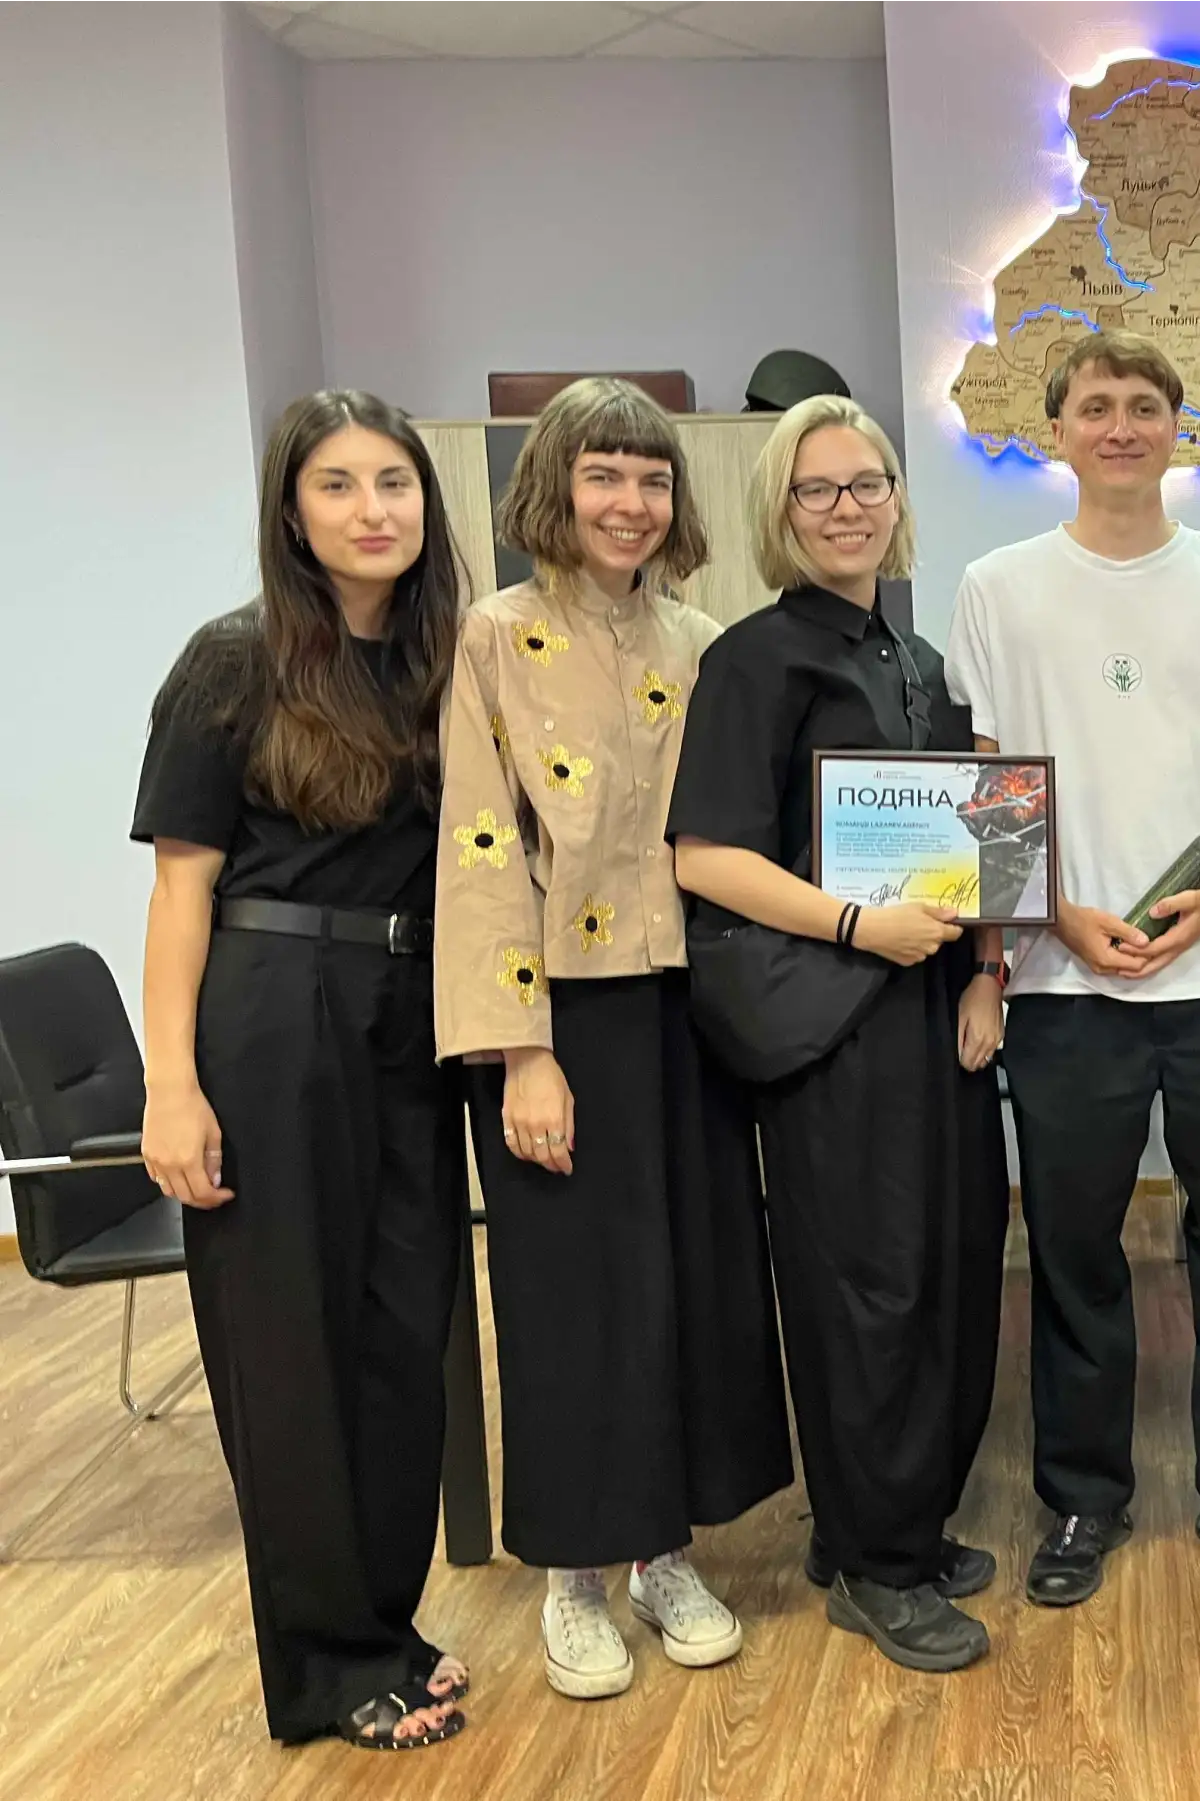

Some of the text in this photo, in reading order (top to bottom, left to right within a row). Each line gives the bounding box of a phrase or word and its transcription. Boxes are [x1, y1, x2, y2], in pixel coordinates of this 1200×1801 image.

[1120, 178, 1159, 192] Луцьк
[1081, 281, 1123, 296] Львів
[837, 786, 954, 811] ПОДЯКА
